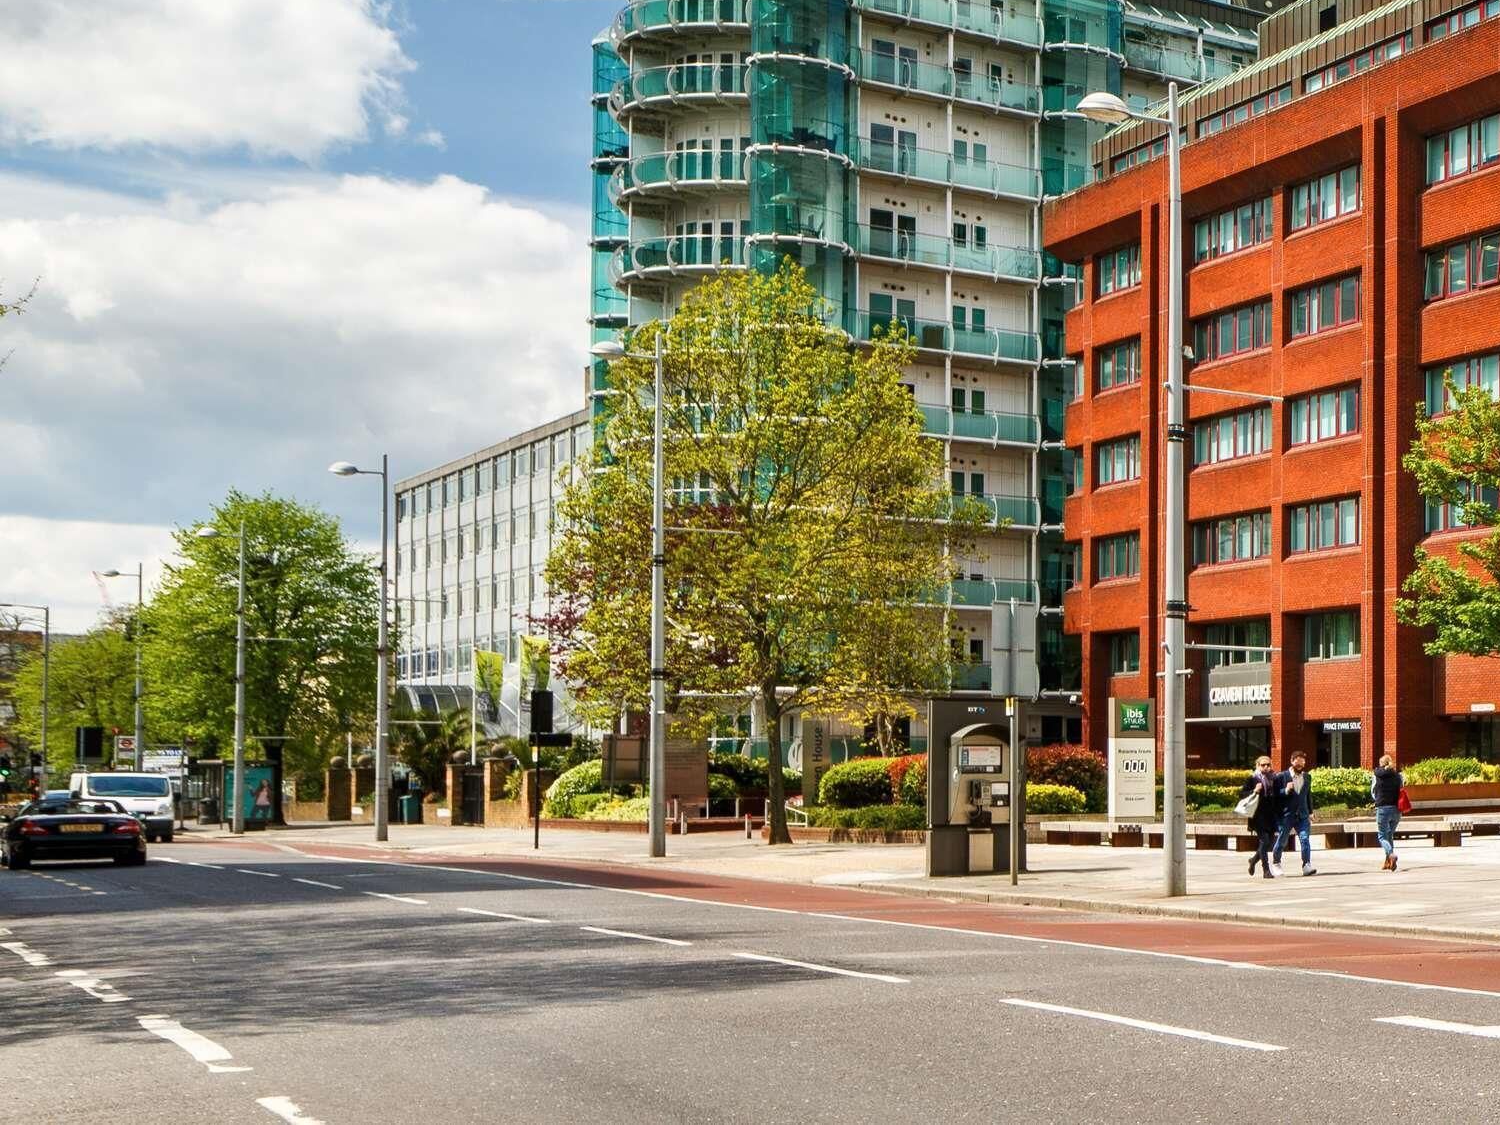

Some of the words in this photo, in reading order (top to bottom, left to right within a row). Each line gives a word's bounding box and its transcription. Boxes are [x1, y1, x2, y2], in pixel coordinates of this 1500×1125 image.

[1210, 686, 1242, 703] CRAVEN
[1244, 684, 1271, 701] HOUSE
[1126, 708, 1144, 719] ibis
[811, 727, 823, 762] House
